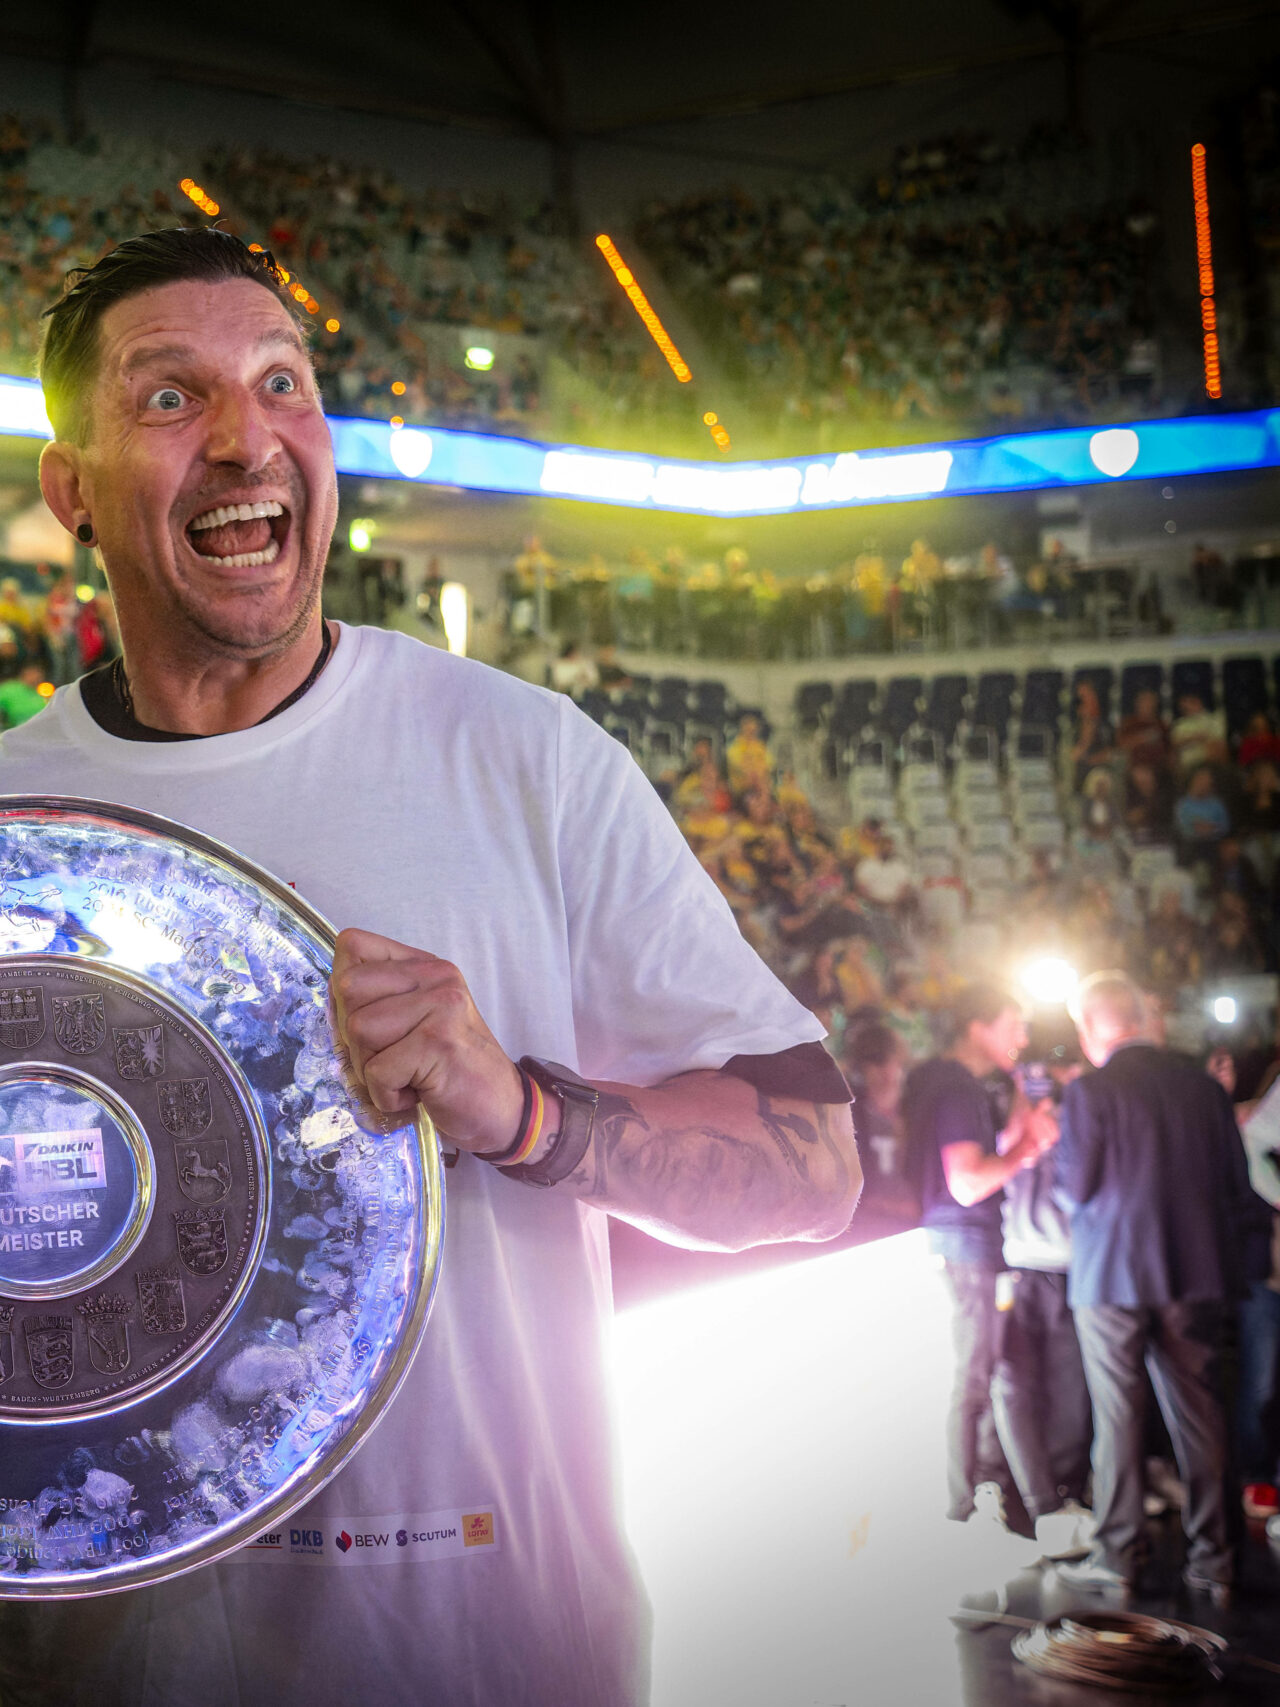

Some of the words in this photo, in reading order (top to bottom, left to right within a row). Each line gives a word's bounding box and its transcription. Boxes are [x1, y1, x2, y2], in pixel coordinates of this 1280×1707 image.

[86, 879, 128, 901] 2016
[158, 923, 251, 995] Magdeburg
[113, 986, 183, 1033] SCHLESWIG-HOLSTEIN
[186, 1036, 245, 1128] MECKLENBURG-VORPOMMERN
[39, 1141, 94, 1155] DAIKIN
[365, 1190, 379, 1227] THW
[230, 1245, 245, 1275] HESSEN
[316, 1340, 347, 1380] THW
[290, 1529, 324, 1547] DKB
[355, 1533, 390, 1548] BEW
[412, 1528, 457, 1542] SCUTUM
